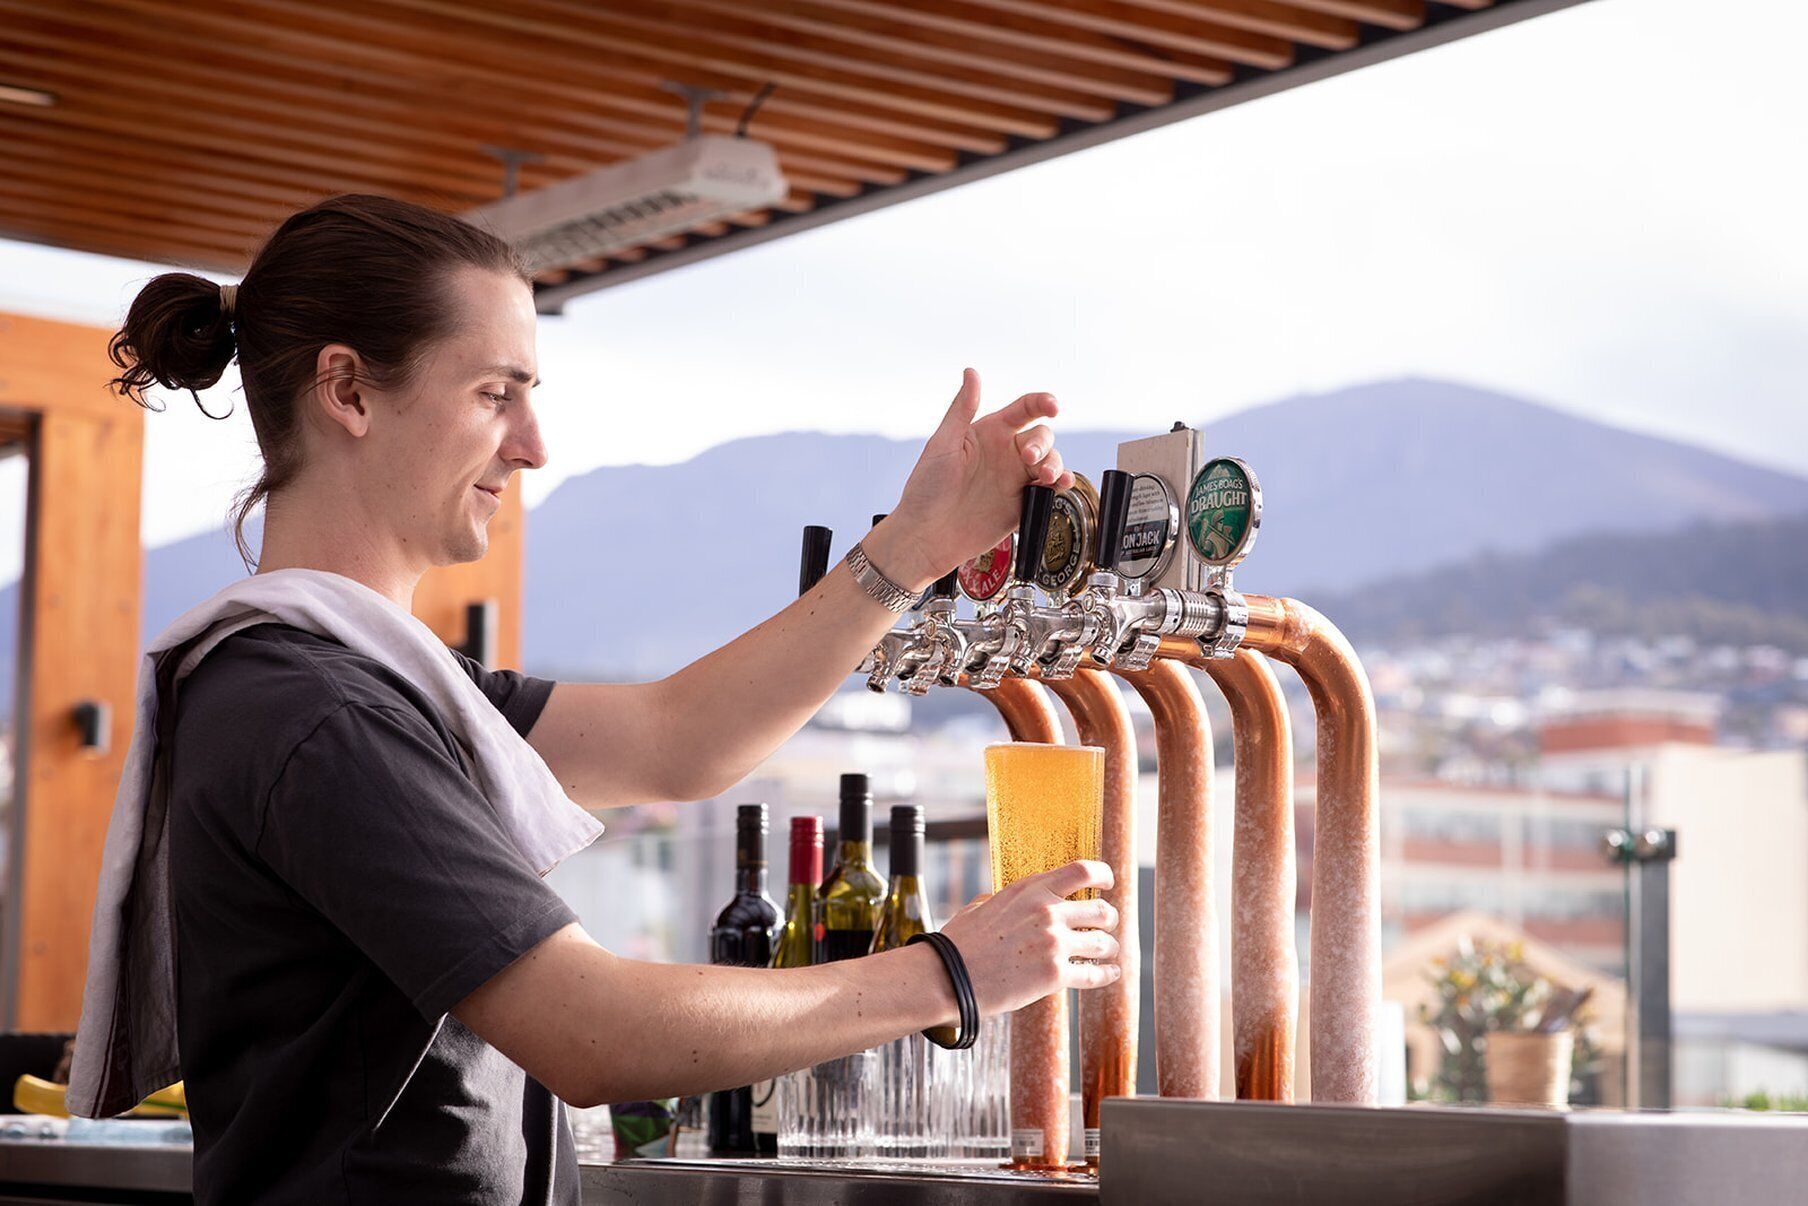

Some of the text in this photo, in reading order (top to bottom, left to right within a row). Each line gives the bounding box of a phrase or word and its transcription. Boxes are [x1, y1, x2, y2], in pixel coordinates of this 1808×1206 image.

[1195, 478, 1243, 497] JAMES BOAG'S
[1191, 491, 1248, 514] DRAUGHT
[1122, 530, 1160, 549] ON JACK
[1042, 542, 1080, 586] GEORGE
[981, 569, 1001, 594] ALE
